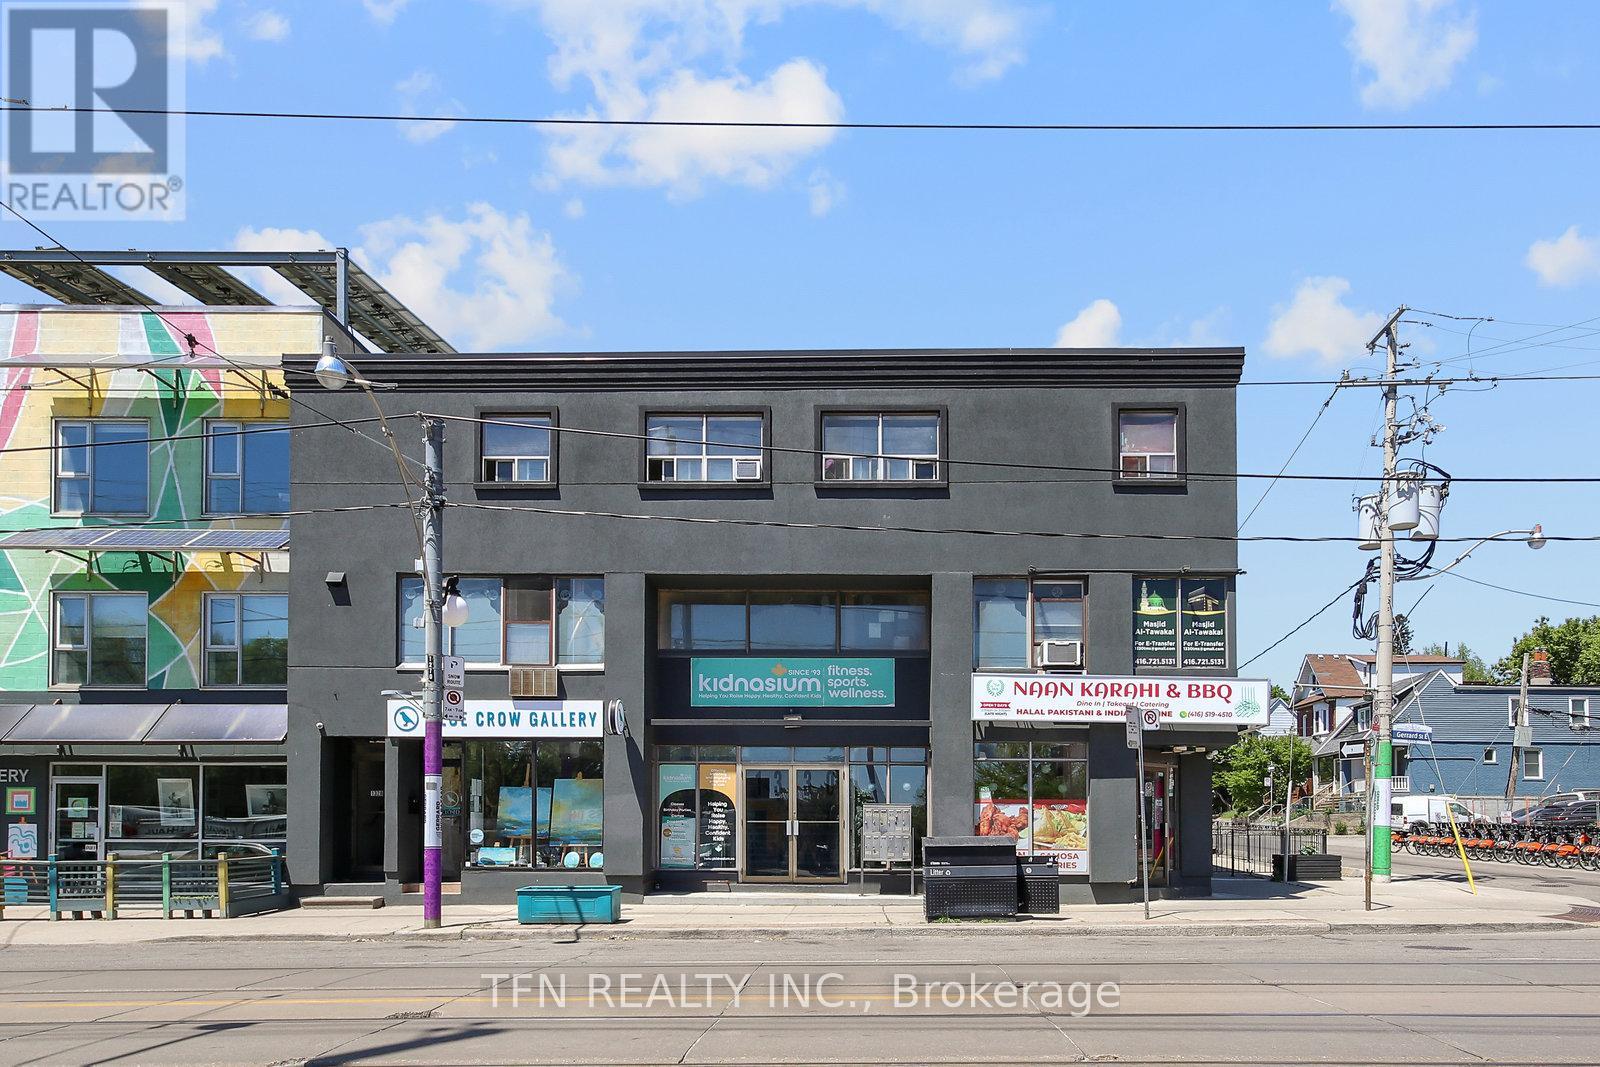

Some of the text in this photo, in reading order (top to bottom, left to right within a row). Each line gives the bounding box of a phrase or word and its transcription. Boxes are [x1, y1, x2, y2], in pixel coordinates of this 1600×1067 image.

[1143, 621, 1166, 629] Masjid
[1192, 621, 1215, 629] Masjid
[827, 665, 873, 676] fitness.
[698, 673, 821, 692] kidnasium
[827, 677, 869, 688] sports.
[828, 688, 887, 699] wellness.
[1013, 681, 1074, 699] NAAN
[1080, 682, 1160, 700] KARAHI
[1166, 683, 1181, 698] &
[1187, 683, 1233, 704] BBQ
[1016, 708, 1045, 716] HALAL
[475, 711, 521, 728] CROW
[529, 711, 597, 728] GALLERY
[1396, 731, 1418, 739] Gerrard
[930, 868, 944, 876] Litter
